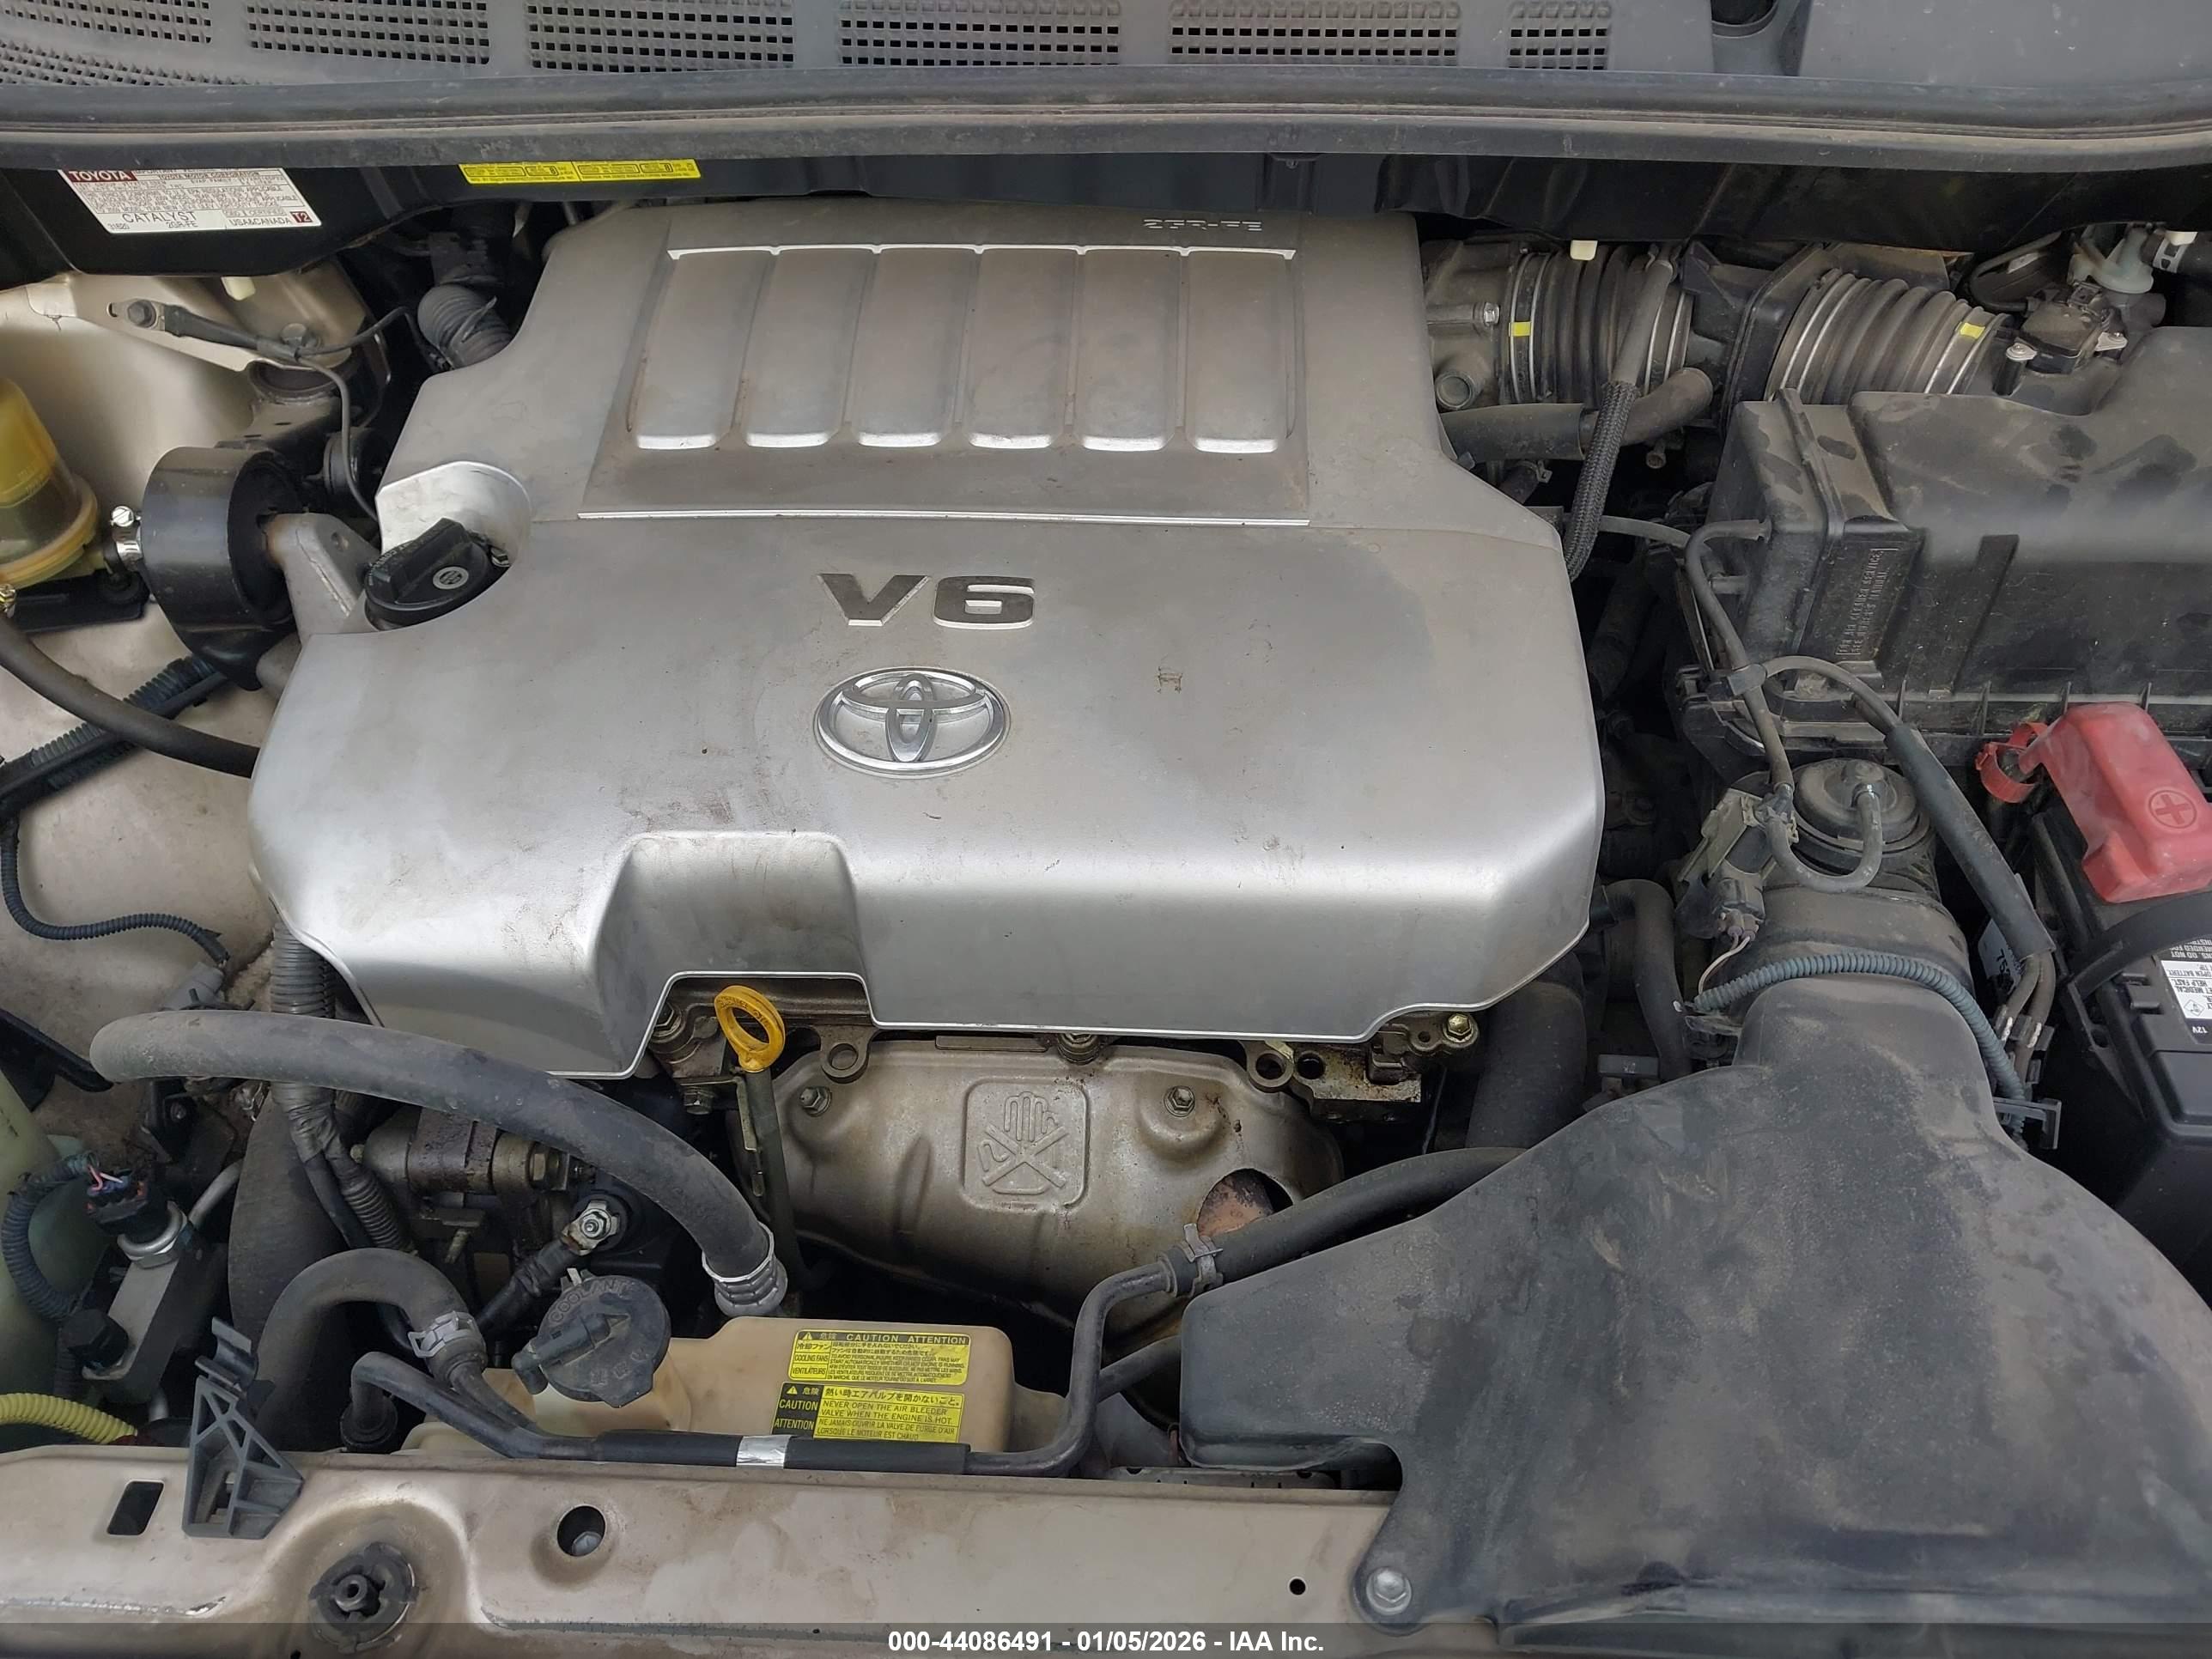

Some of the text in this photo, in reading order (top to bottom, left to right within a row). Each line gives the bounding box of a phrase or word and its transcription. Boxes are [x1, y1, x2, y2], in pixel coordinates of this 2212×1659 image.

[70, 171, 131, 181] TOYOTA
[122, 211, 198, 223] CATALYST
[229, 217, 292, 226] USA&CANADA
[295, 211, 311, 222] T2
[817, 573, 1036, 630] V6
[846, 1334, 967, 1345] CAUTION ATTENTION
[779, 1399, 818, 1411] CAUTION
[823, 1400, 850, 1408] NEVER
[851, 1401, 874, 1409] OPEN
[909, 1407, 948, 1415] BLEEDER
[820, 1408, 846, 1417] VALVE
[847, 1410, 872, 1419] WHEN
[891, 1413, 922, 1422] ENGINE
[774, 1418, 815, 1431] ATTENTION
